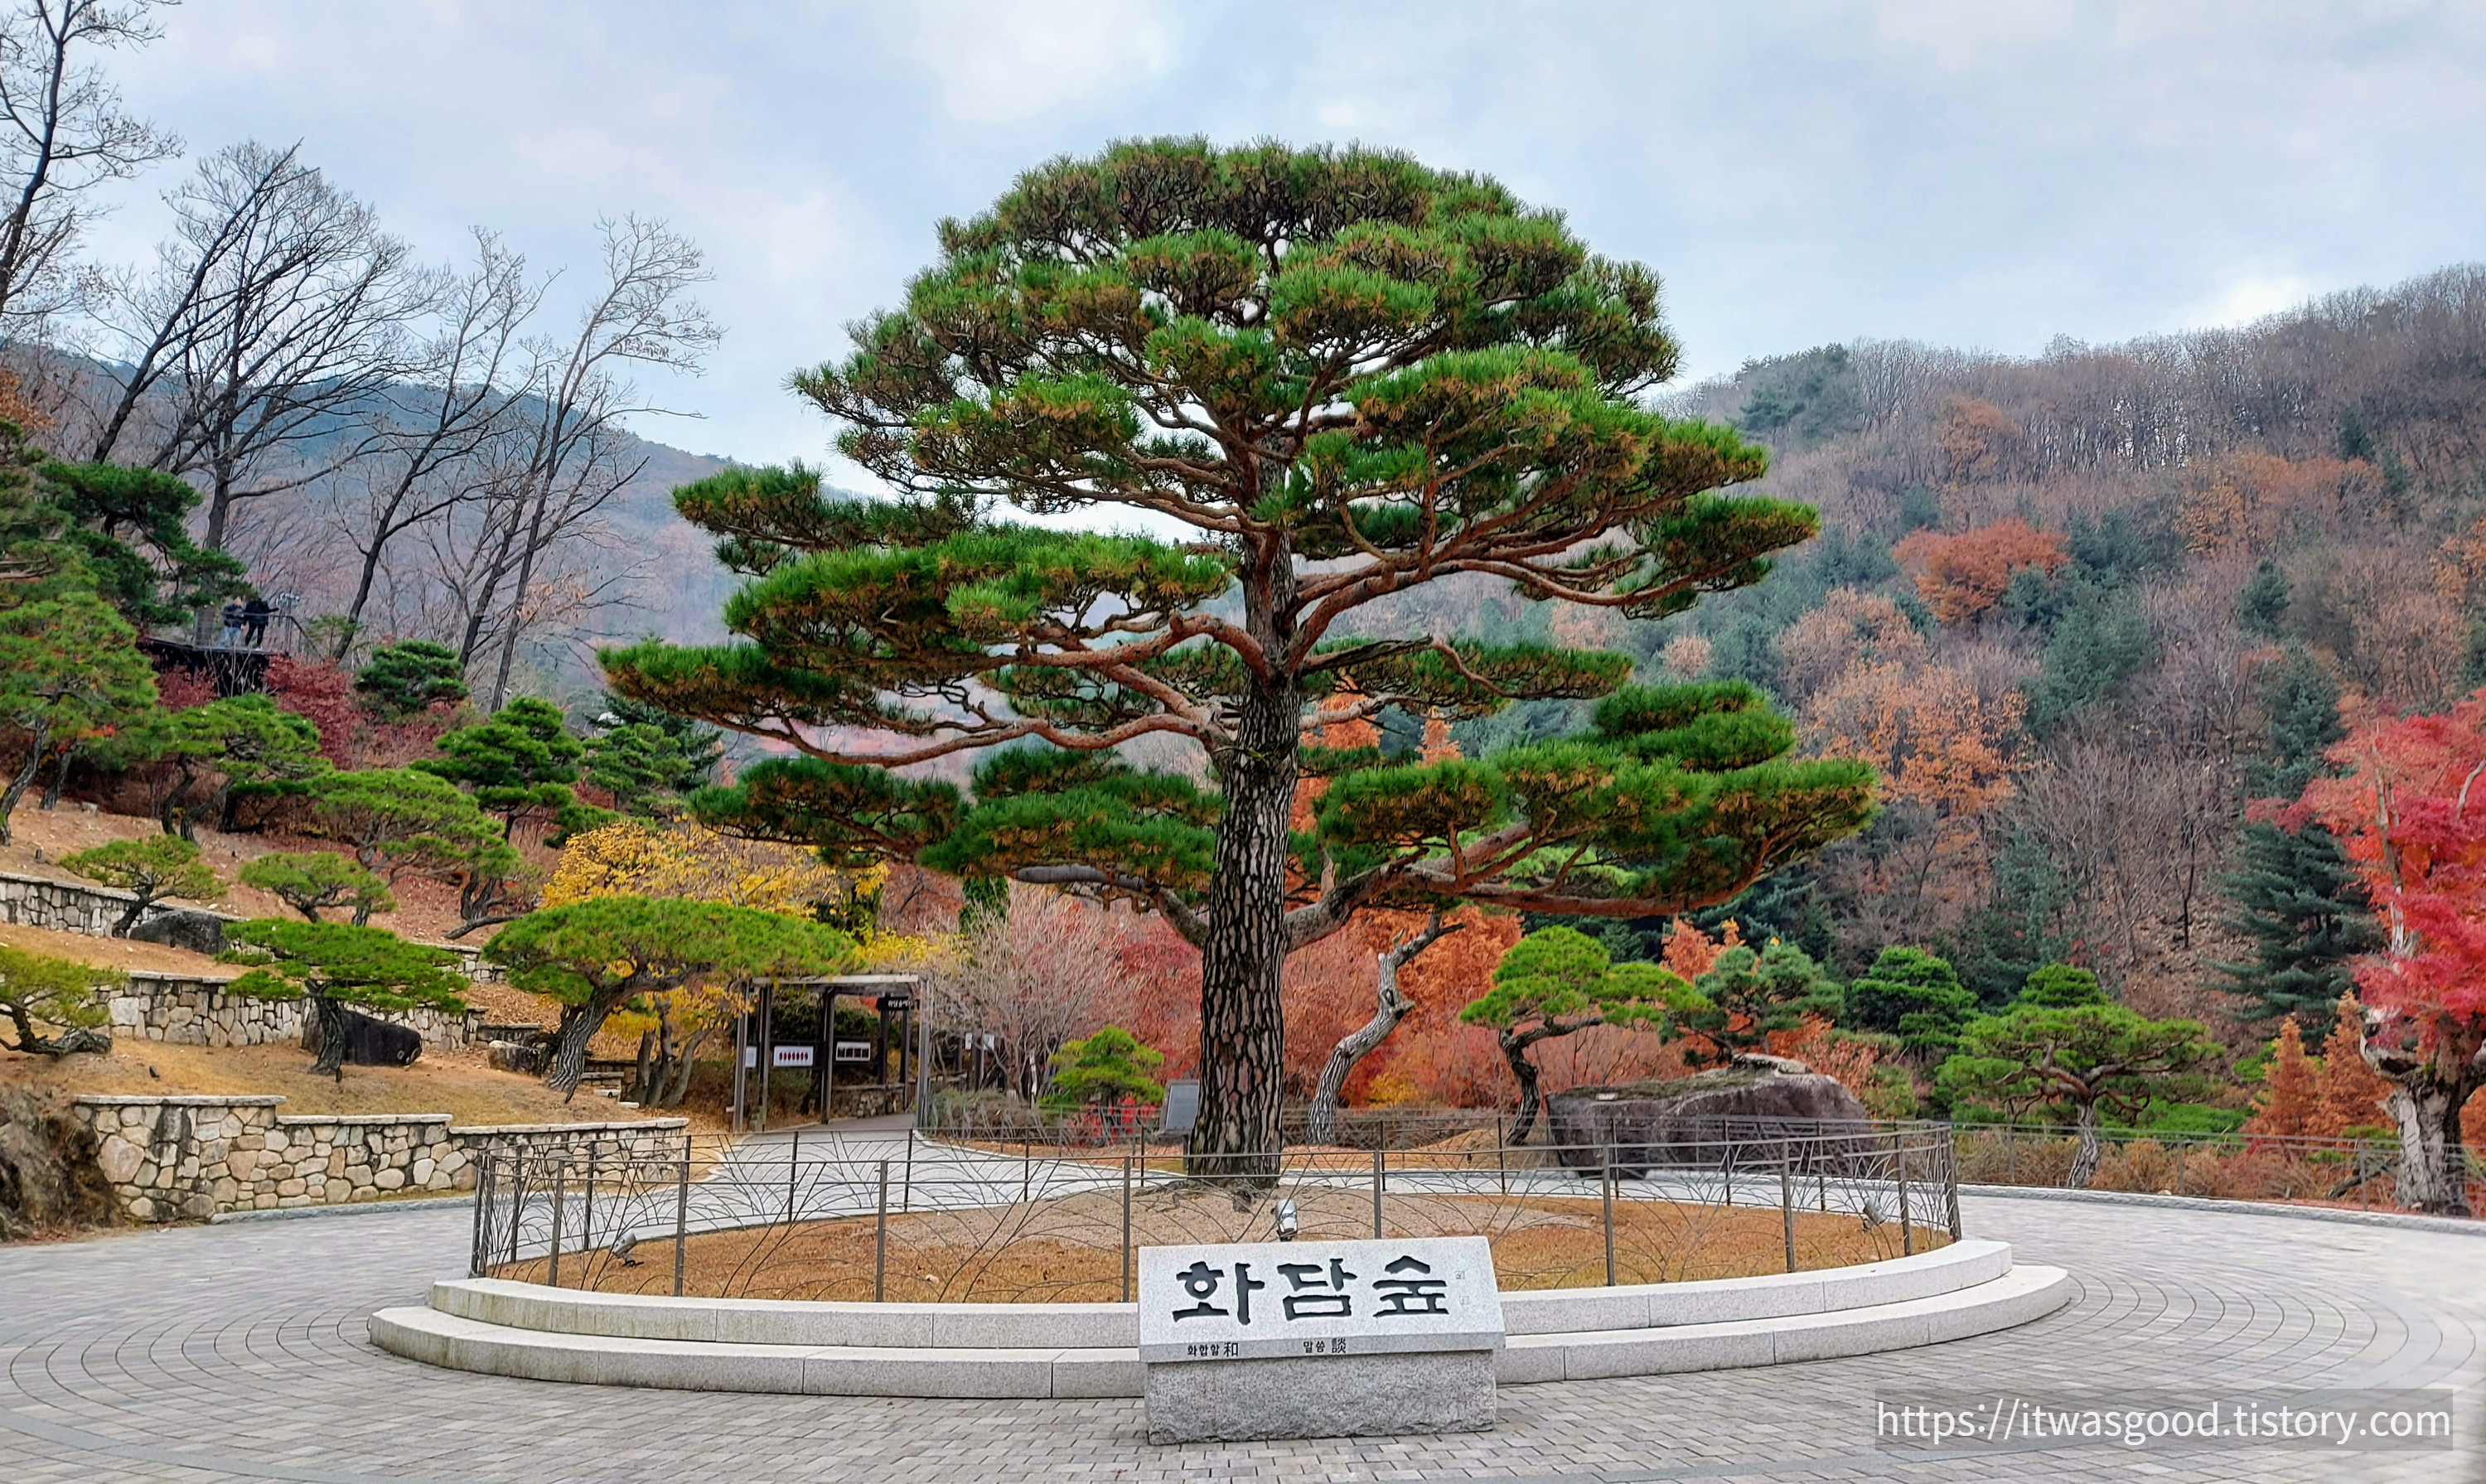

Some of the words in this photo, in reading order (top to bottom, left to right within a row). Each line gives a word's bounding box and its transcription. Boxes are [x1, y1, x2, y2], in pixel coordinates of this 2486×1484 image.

[1172, 1254, 1449, 1326] 화담숲
[1187, 1344, 1220, 1357] 화합할
[1223, 1341, 1239, 1357] 和
[1303, 1341, 1326, 1354] 말씀
[1331, 1337, 1347, 1354] 談
